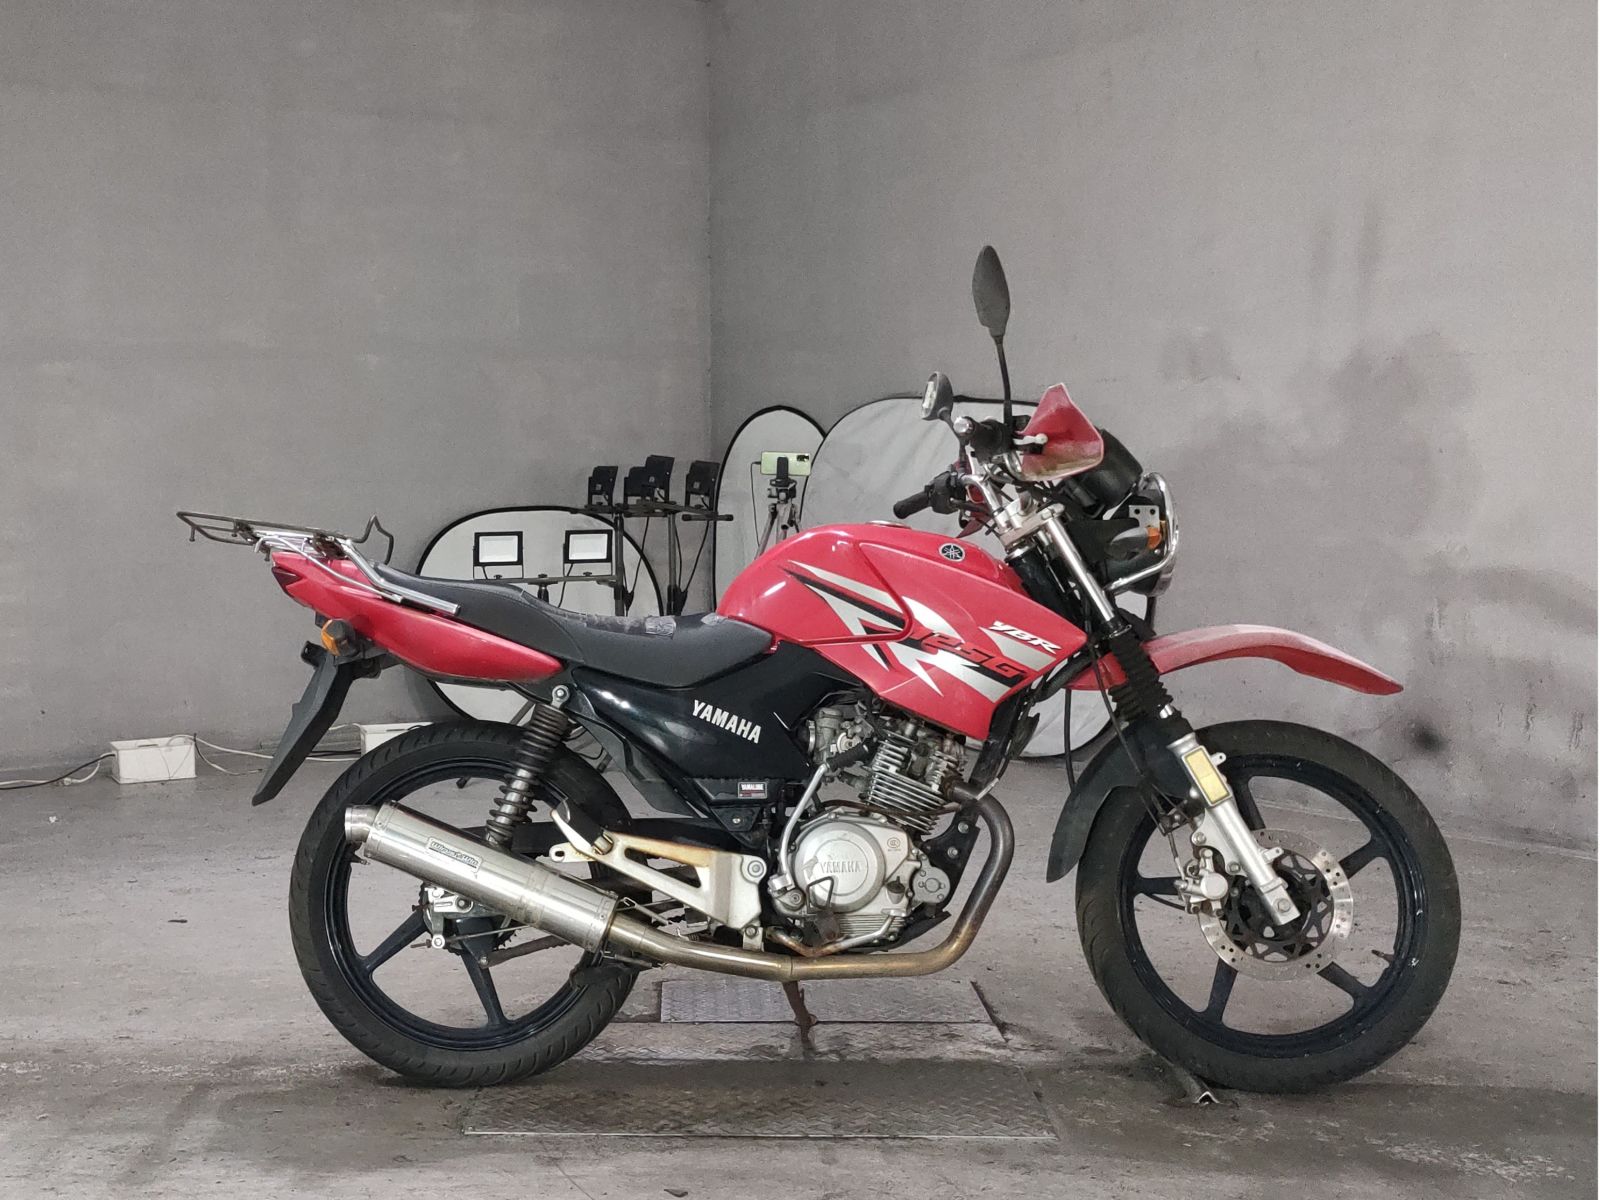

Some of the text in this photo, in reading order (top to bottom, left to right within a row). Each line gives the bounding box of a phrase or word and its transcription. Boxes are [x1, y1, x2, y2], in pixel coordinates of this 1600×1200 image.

[910, 627, 1028, 679] 125G
[988, 620, 1062, 655] YBR
[692, 699, 762, 744] YAMAHA
[820, 861, 861, 874] YAMAHA
